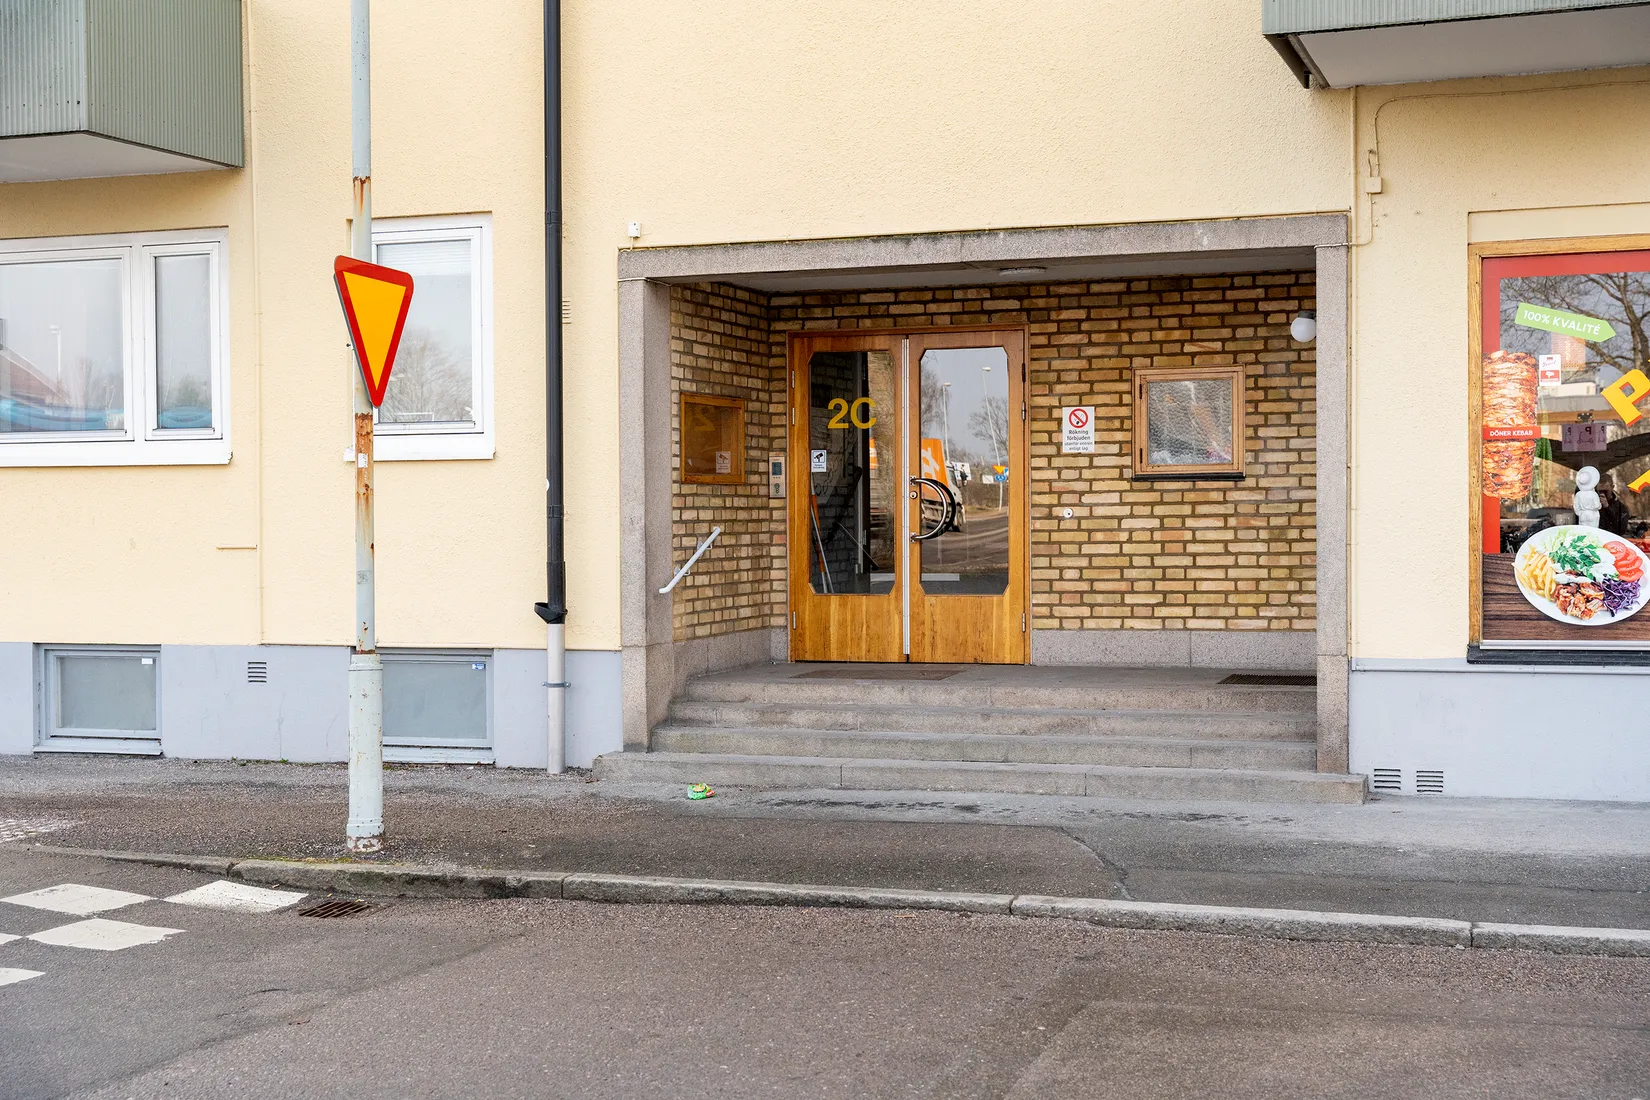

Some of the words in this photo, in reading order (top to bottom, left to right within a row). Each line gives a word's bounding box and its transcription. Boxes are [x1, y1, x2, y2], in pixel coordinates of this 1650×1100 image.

[1523, 310, 1550, 325] 100%
[1552, 316, 1601, 336] KVALITÉ
[827, 397, 877, 429] 2C
[1600, 369, 1650, 428] P
